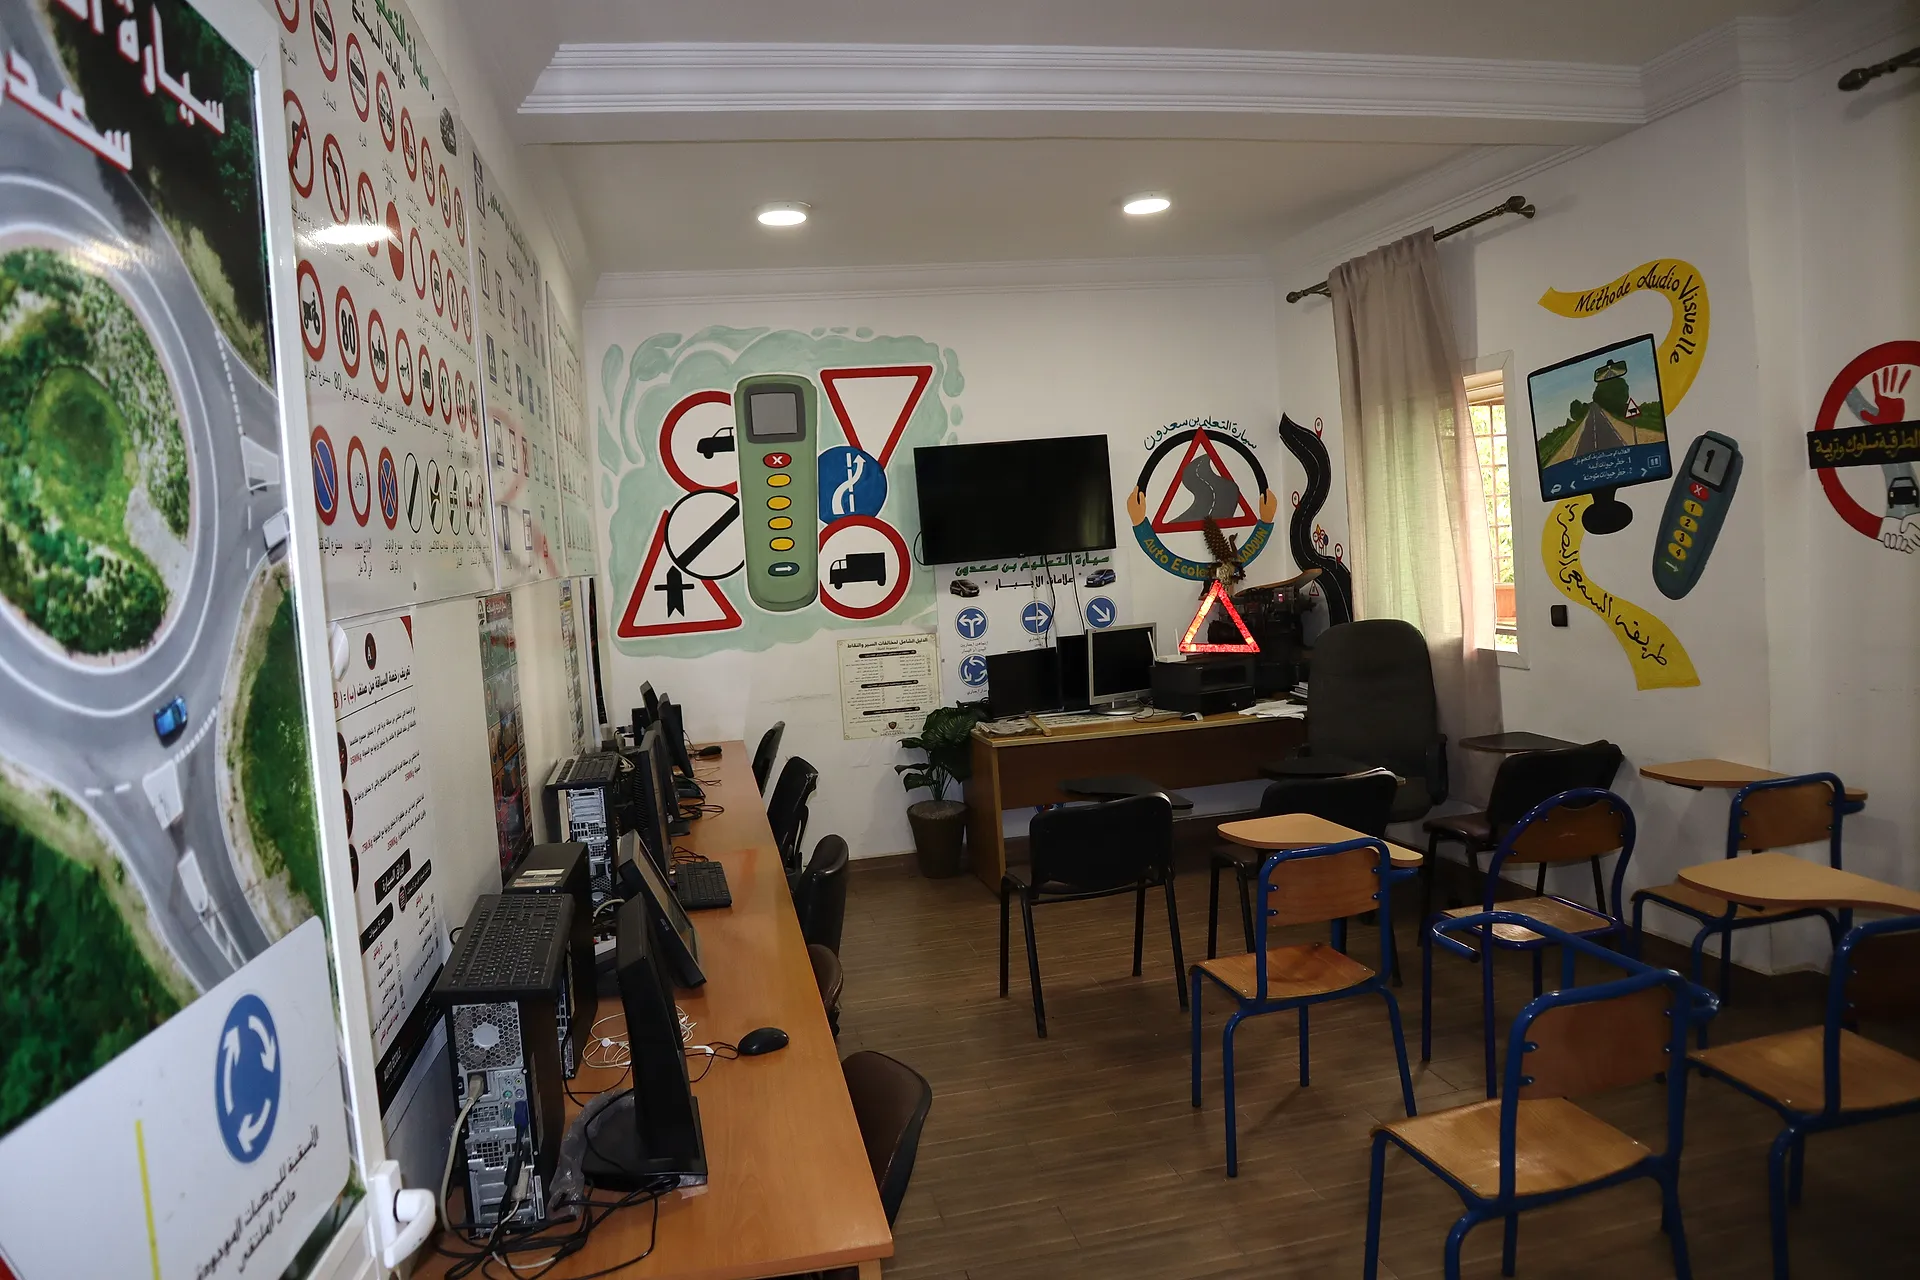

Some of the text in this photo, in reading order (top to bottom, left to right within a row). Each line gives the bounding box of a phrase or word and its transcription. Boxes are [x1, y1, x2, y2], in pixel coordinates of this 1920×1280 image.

[1636, 262, 1680, 292] Audio
[1670, 274, 1700, 364] Visuelle
[341, 309, 356, 356] 80
[332, 369, 342, 392] 80
[1144, 416, 1258, 450] سيارة التعليم بن سعدون
[1614, 458, 1625, 468] خطر
[1615, 468, 1626, 478] خطر
[1704, 449, 1716, 473] 1
[1690, 504, 1695, 512] 1
[1556, 503, 1579, 567] البصري
[1684, 519, 1691, 527] 2
[1679, 533, 1685, 543] 3
[1144, 538, 1169, 564] Auto
[1676, 548, 1681, 556] 4
[955, 552, 1110, 577] سيارة التعليم بن سعدون
[1559, 567, 1613, 618] السمعي
[374, 671, 388, 692] السياقة
[277, 1189, 296, 1224] داخل
